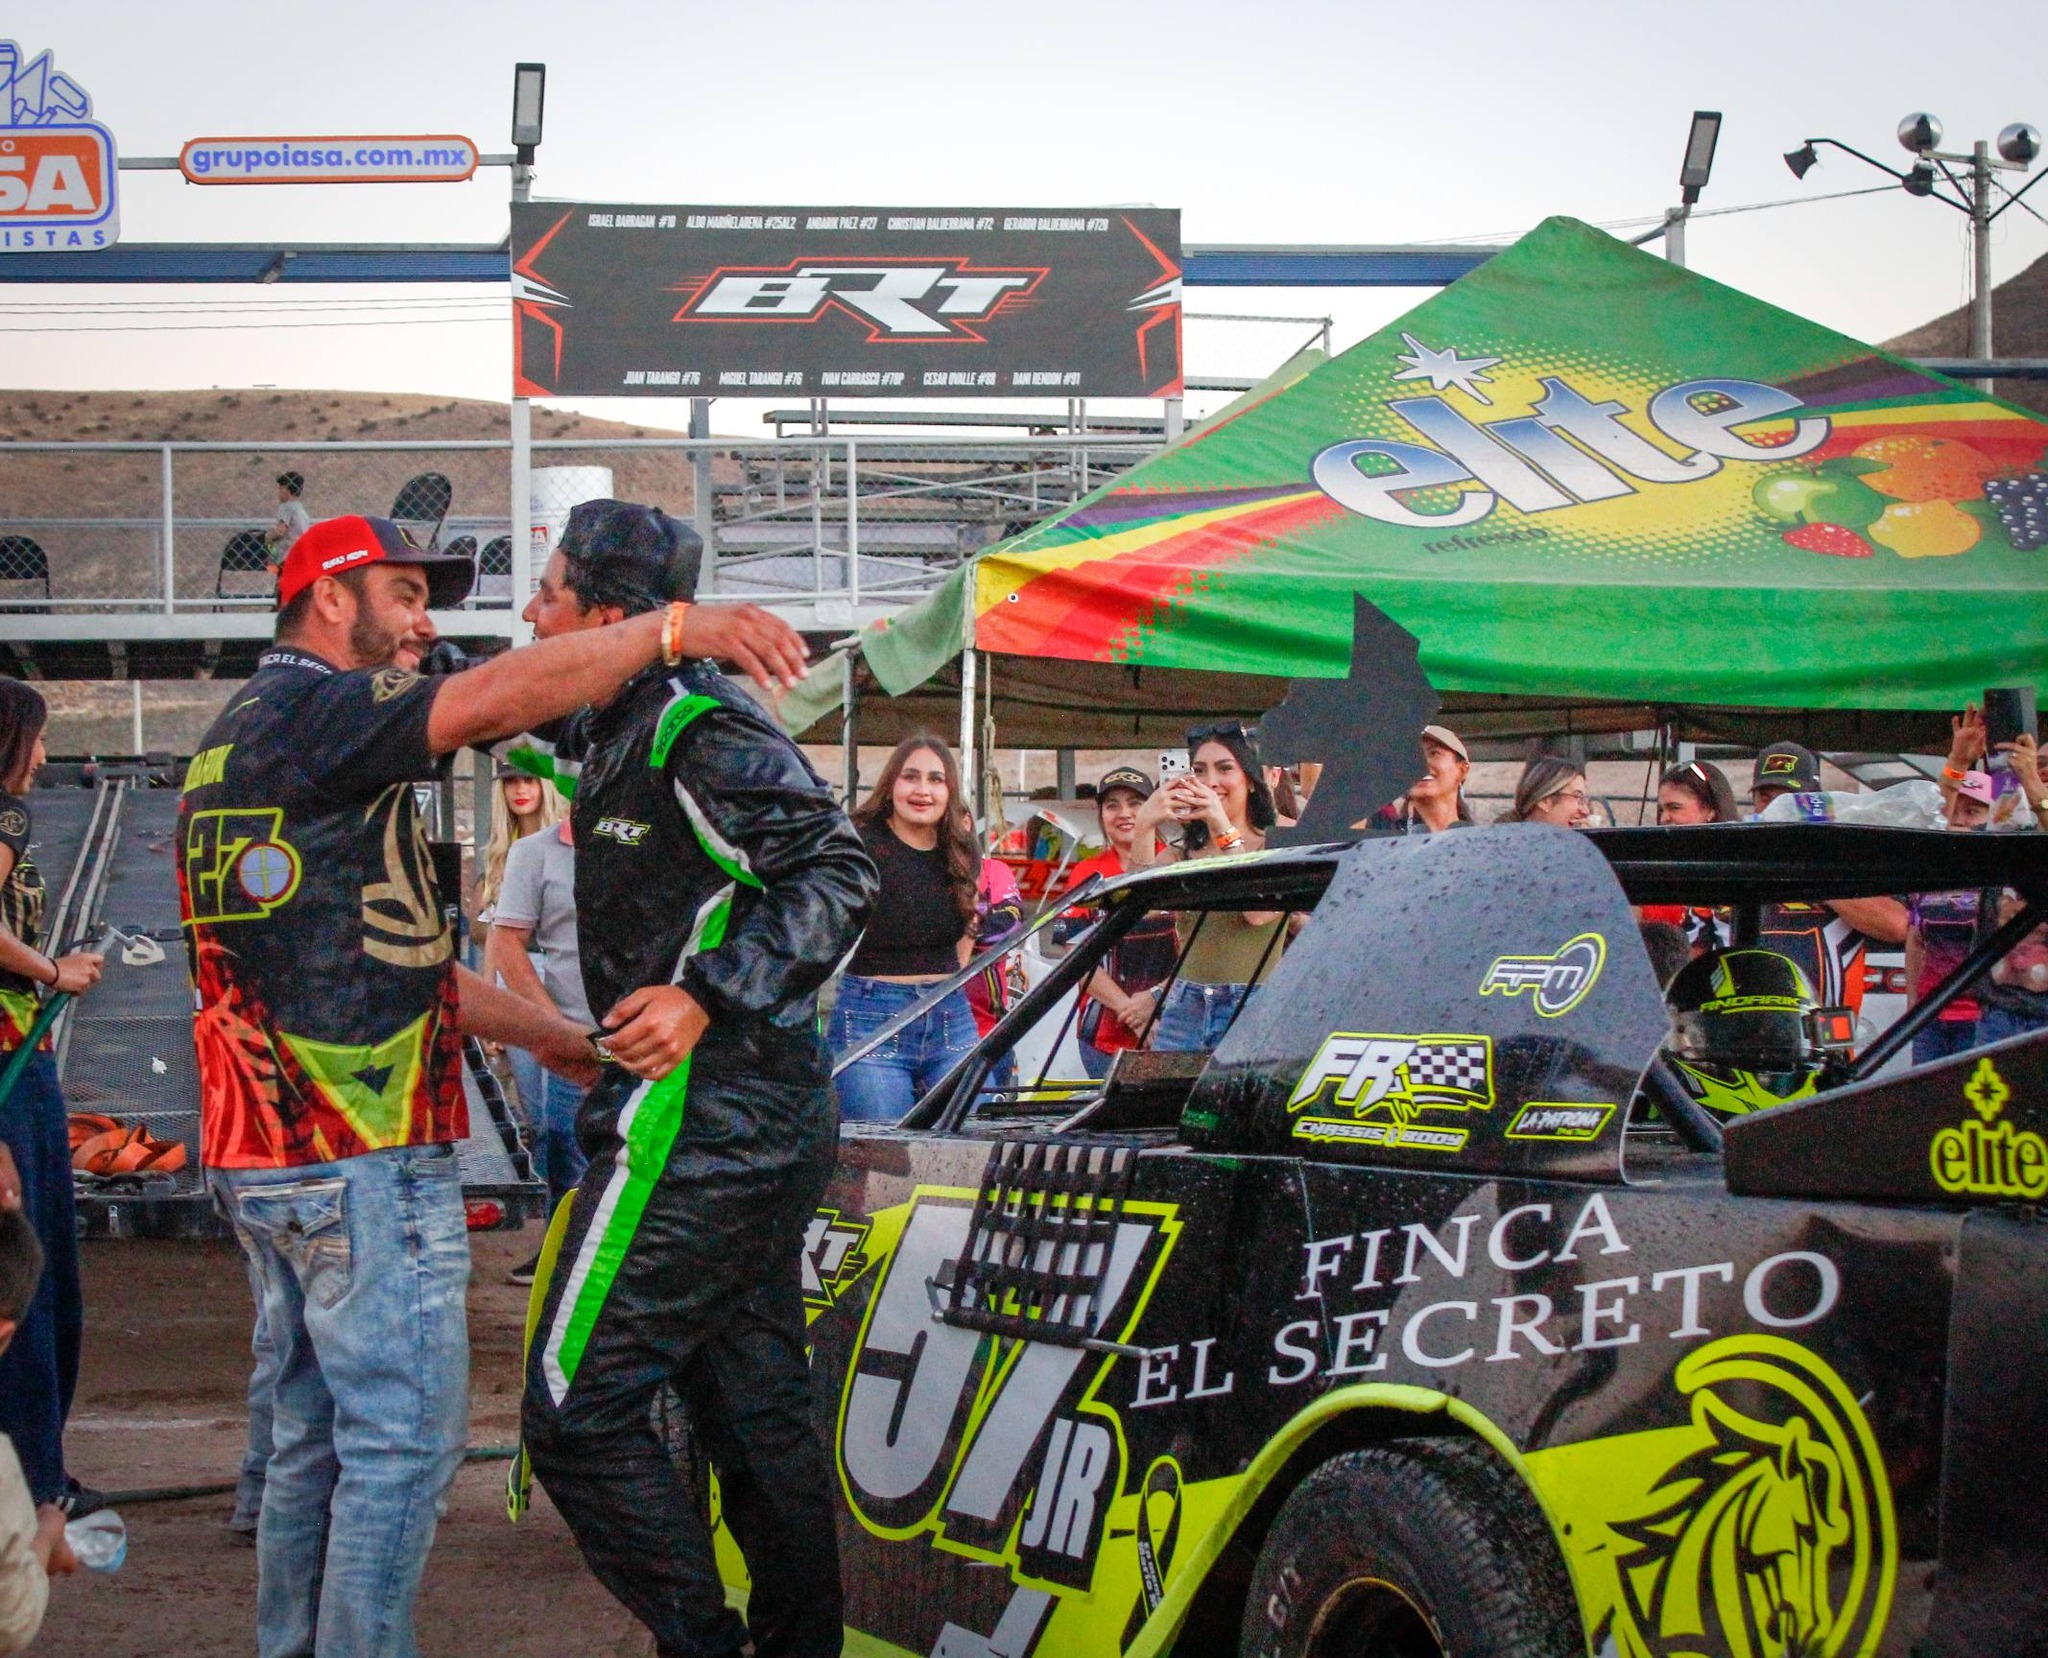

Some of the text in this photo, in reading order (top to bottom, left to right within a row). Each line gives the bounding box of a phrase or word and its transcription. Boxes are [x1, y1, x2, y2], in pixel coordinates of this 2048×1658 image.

[192, 143, 467, 173] grupoiasa.com.mx
[588, 213, 615, 227] ISRAEL
[1310, 376, 1832, 528] elite
[1421, 527, 1549, 554] refresco
[1296, 1121, 1387, 1141] CHASSIS
[1400, 1129, 1466, 1148] BODY
[1934, 1122, 2047, 1193] elite
[1301, 1193, 1631, 1302] FINCA
[1129, 1251, 1840, 1409] EL SECRETO
